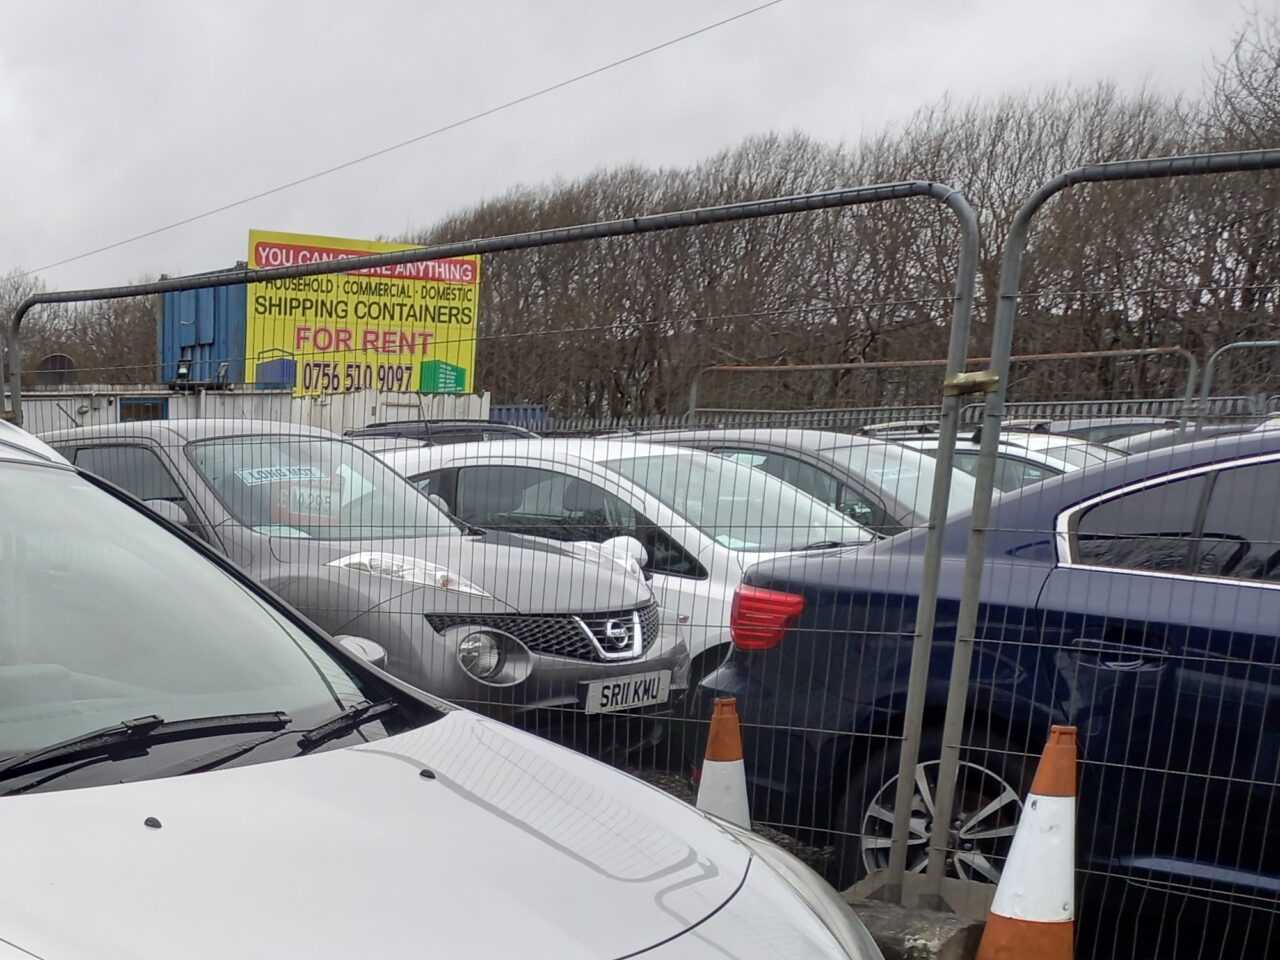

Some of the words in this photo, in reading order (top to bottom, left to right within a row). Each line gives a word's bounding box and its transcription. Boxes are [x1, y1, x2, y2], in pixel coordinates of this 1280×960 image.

[258, 247, 295, 266] YOU
[395, 260, 472, 280] ANYTHING
[265, 278, 334, 294] HOUSEHOLD
[343, 280, 412, 299] COMMERCIAL
[421, 285, 473, 302] DOMESTIC
[255, 295, 348, 319] SHIPPING
[354, 300, 472, 325] CONTAINERS
[295, 325, 352, 352] FOR
[362, 328, 433, 355] RENT
[303, 361, 340, 392] 0756
[344, 363, 372, 392] 510
[378, 363, 413, 392] 9097
[249, 467, 288, 481] LONG
[632, 677, 660, 703] KMU
